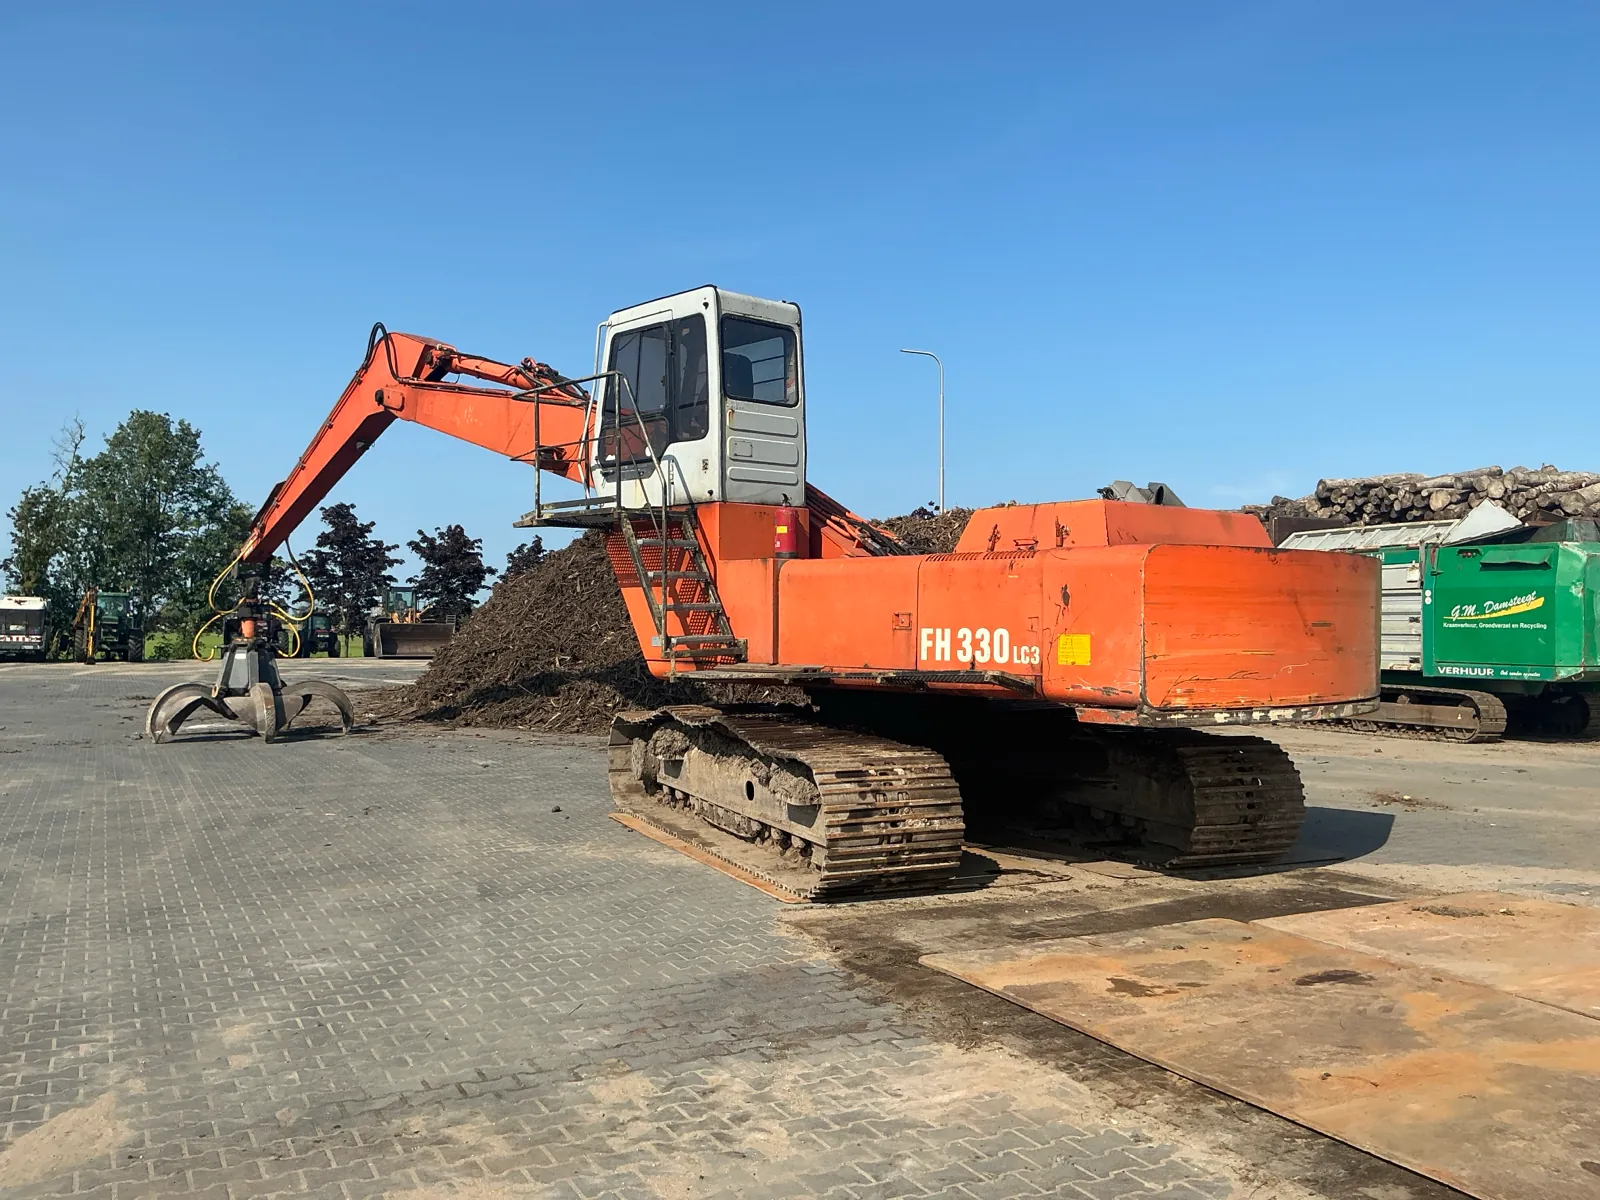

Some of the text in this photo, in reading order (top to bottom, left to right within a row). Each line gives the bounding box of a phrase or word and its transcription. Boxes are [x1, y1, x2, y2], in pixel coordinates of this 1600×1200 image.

[1451, 590, 1537, 621] G.M. Damsteegt
[1519, 622, 1547, 630] Recycling
[920, 627, 951, 661] FH
[956, 627, 1010, 664] 330
[1013, 645, 1040, 664] LC3
[1438, 666, 1494, 676] VERHUUR
